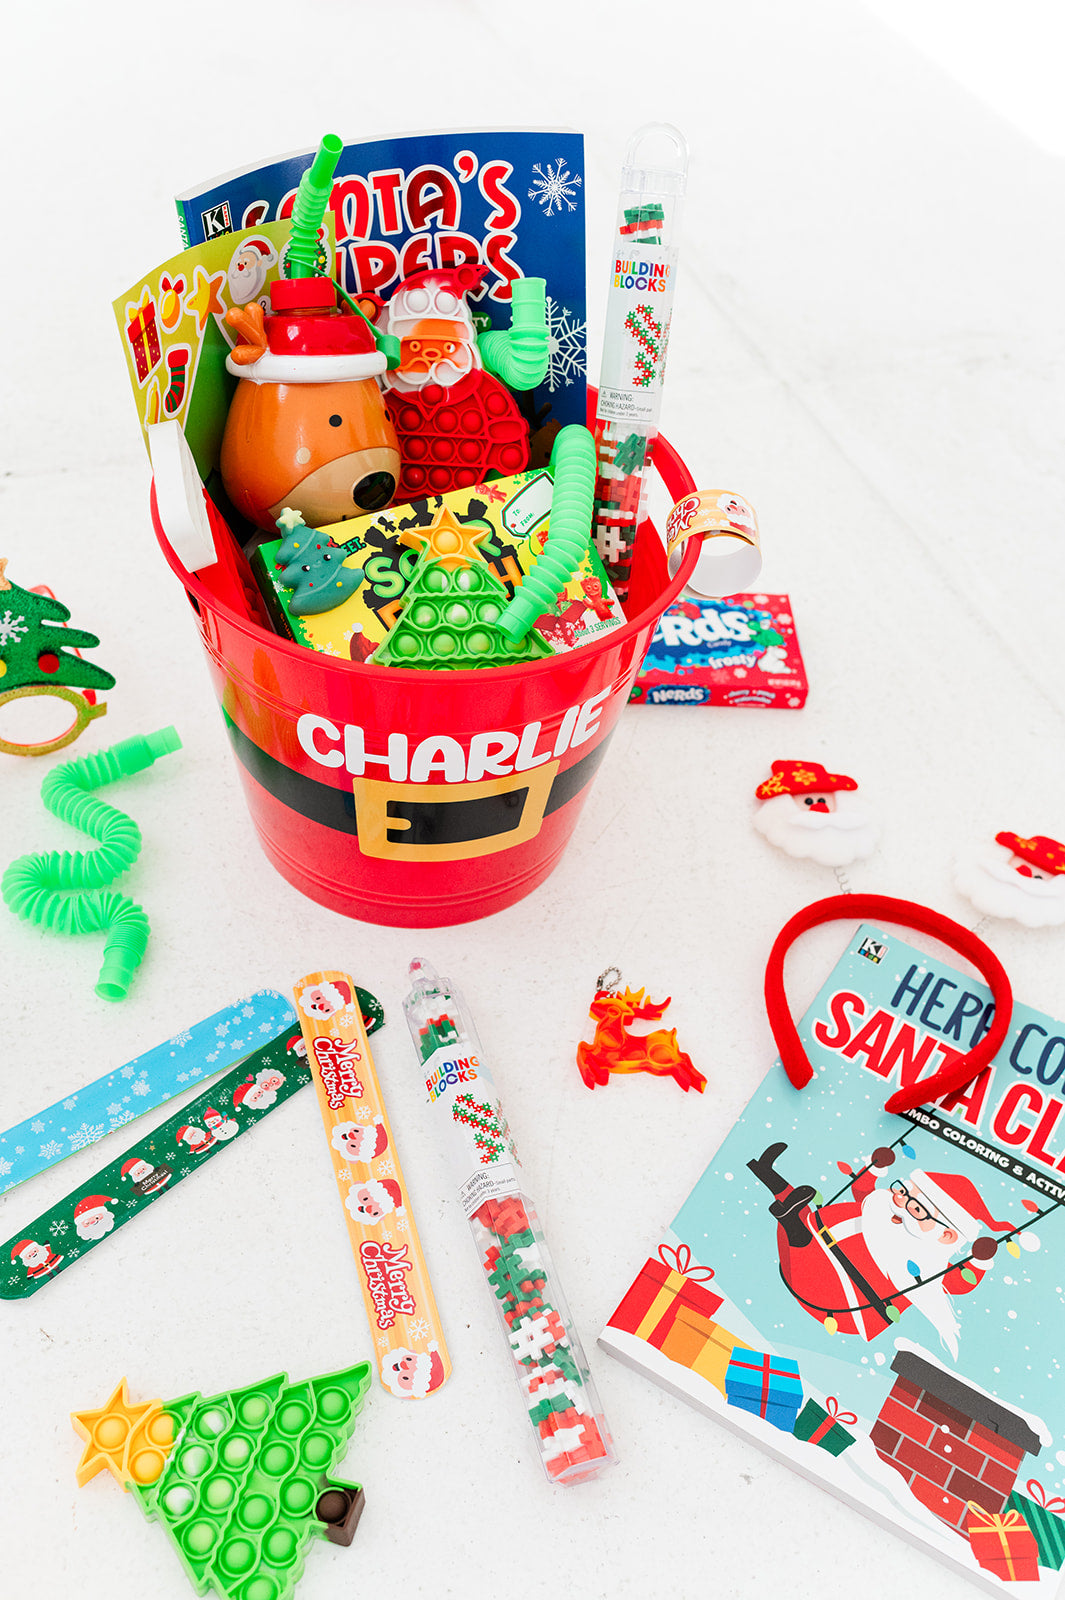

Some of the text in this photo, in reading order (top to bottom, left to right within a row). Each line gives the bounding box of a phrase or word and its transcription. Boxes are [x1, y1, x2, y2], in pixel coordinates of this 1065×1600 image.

[242, 150, 521, 243] NTA'S
[613, 274, 666, 292] BLOCKS
[615, 259, 671, 278] BUILDING
[340, 537, 367, 557] EET.
[589, 624, 595, 634] 3
[594, 616, 622, 632] SERVINGS
[708, 654, 757, 670] frosty
[296, 686, 612, 783] CHARLIE
[313, 1036, 345, 1110] Christmas
[333, 1038, 364, 1099] Merry
[425, 1055, 480, 1092] BUILDING
[429, 1068, 478, 1103] BLOCKS
[1009, 1023, 1065, 1096] CO
[902, 1108, 1065, 1201] MBO COLORING & ACTIV
[990, 1081, 1065, 1176] CL
[360, 1240, 396, 1331] Christmas
[381, 1242, 416, 1316] Merry
